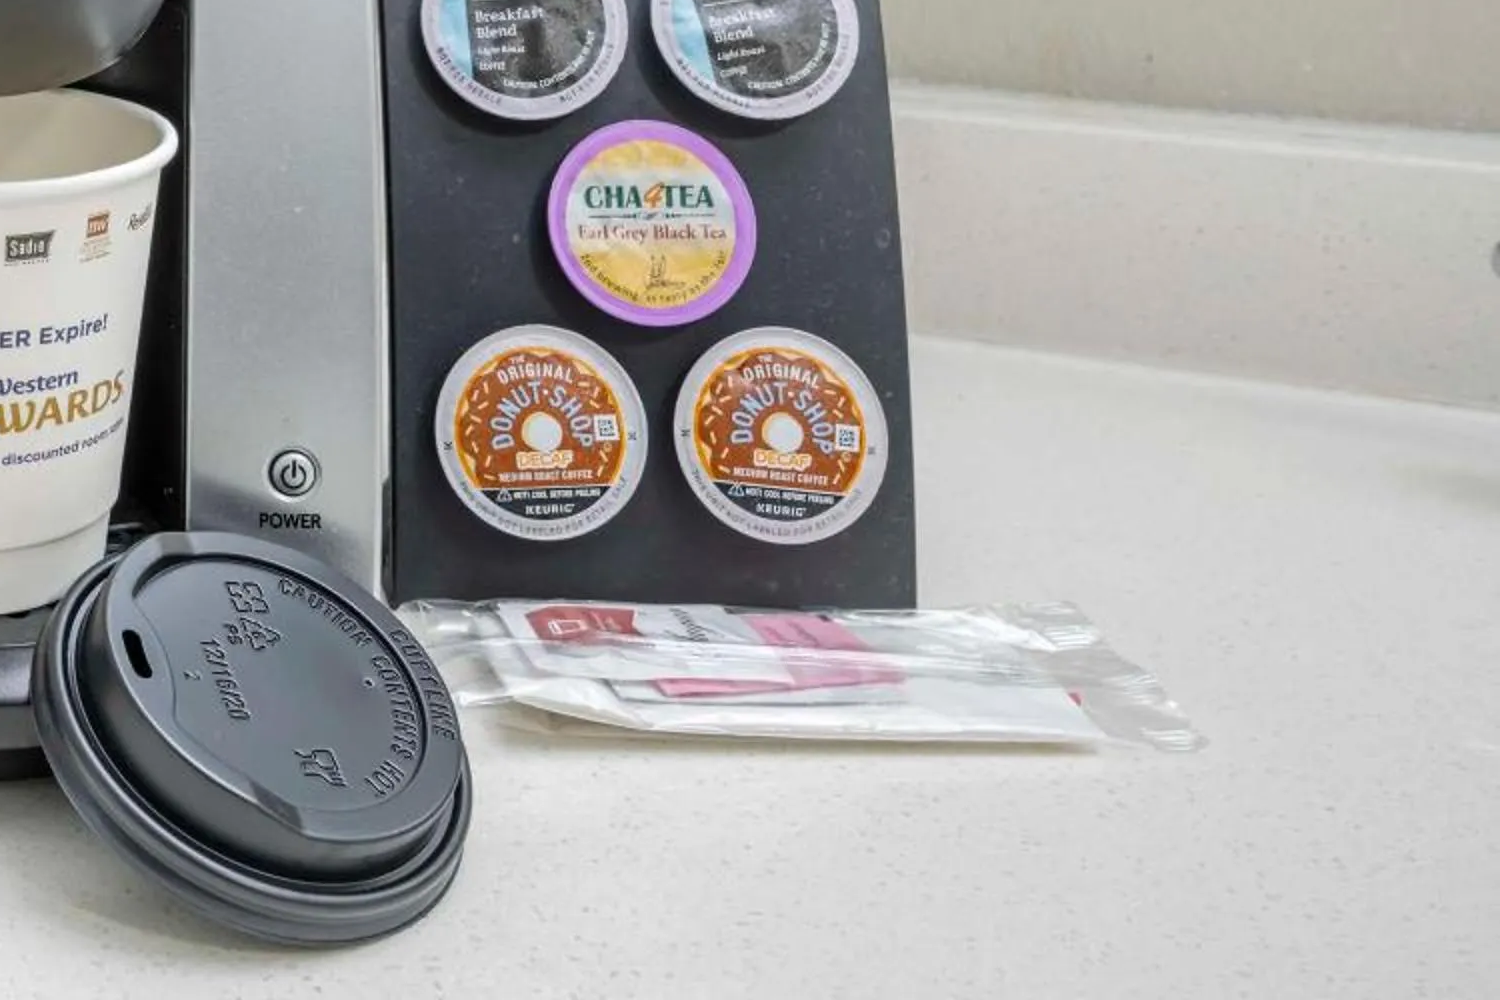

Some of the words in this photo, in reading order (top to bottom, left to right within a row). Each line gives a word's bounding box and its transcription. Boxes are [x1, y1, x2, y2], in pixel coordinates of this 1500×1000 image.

[475, 23, 517, 39] Blend
[714, 25, 753, 43] Blend
[578, 224, 609, 241] Earl
[612, 225, 649, 244] Grey
[652, 224, 696, 240] Black
[701, 224, 727, 240] Tea
[38, 313, 109, 346] Expire!
[496, 362, 574, 385] ORIGINAL
[740, 363, 820, 390] ORIGINAL
[490, 381, 540, 450] DONUT
[548, 385, 594, 448] SHOP
[730, 381, 789, 445] DONUT
[792, 389, 835, 455] SHOP
[1, 440, 80, 466] discounted
[258, 512, 323, 529] POWER
[525, 503, 573, 516] KEURIG
[755, 503, 805, 517] KEURIG
[277, 576, 372, 648] CAUTION
[200, 638, 251, 720] 12/16/20
[371, 654, 417, 761] CONTENTS
[364, 760, 405, 798] HOT
